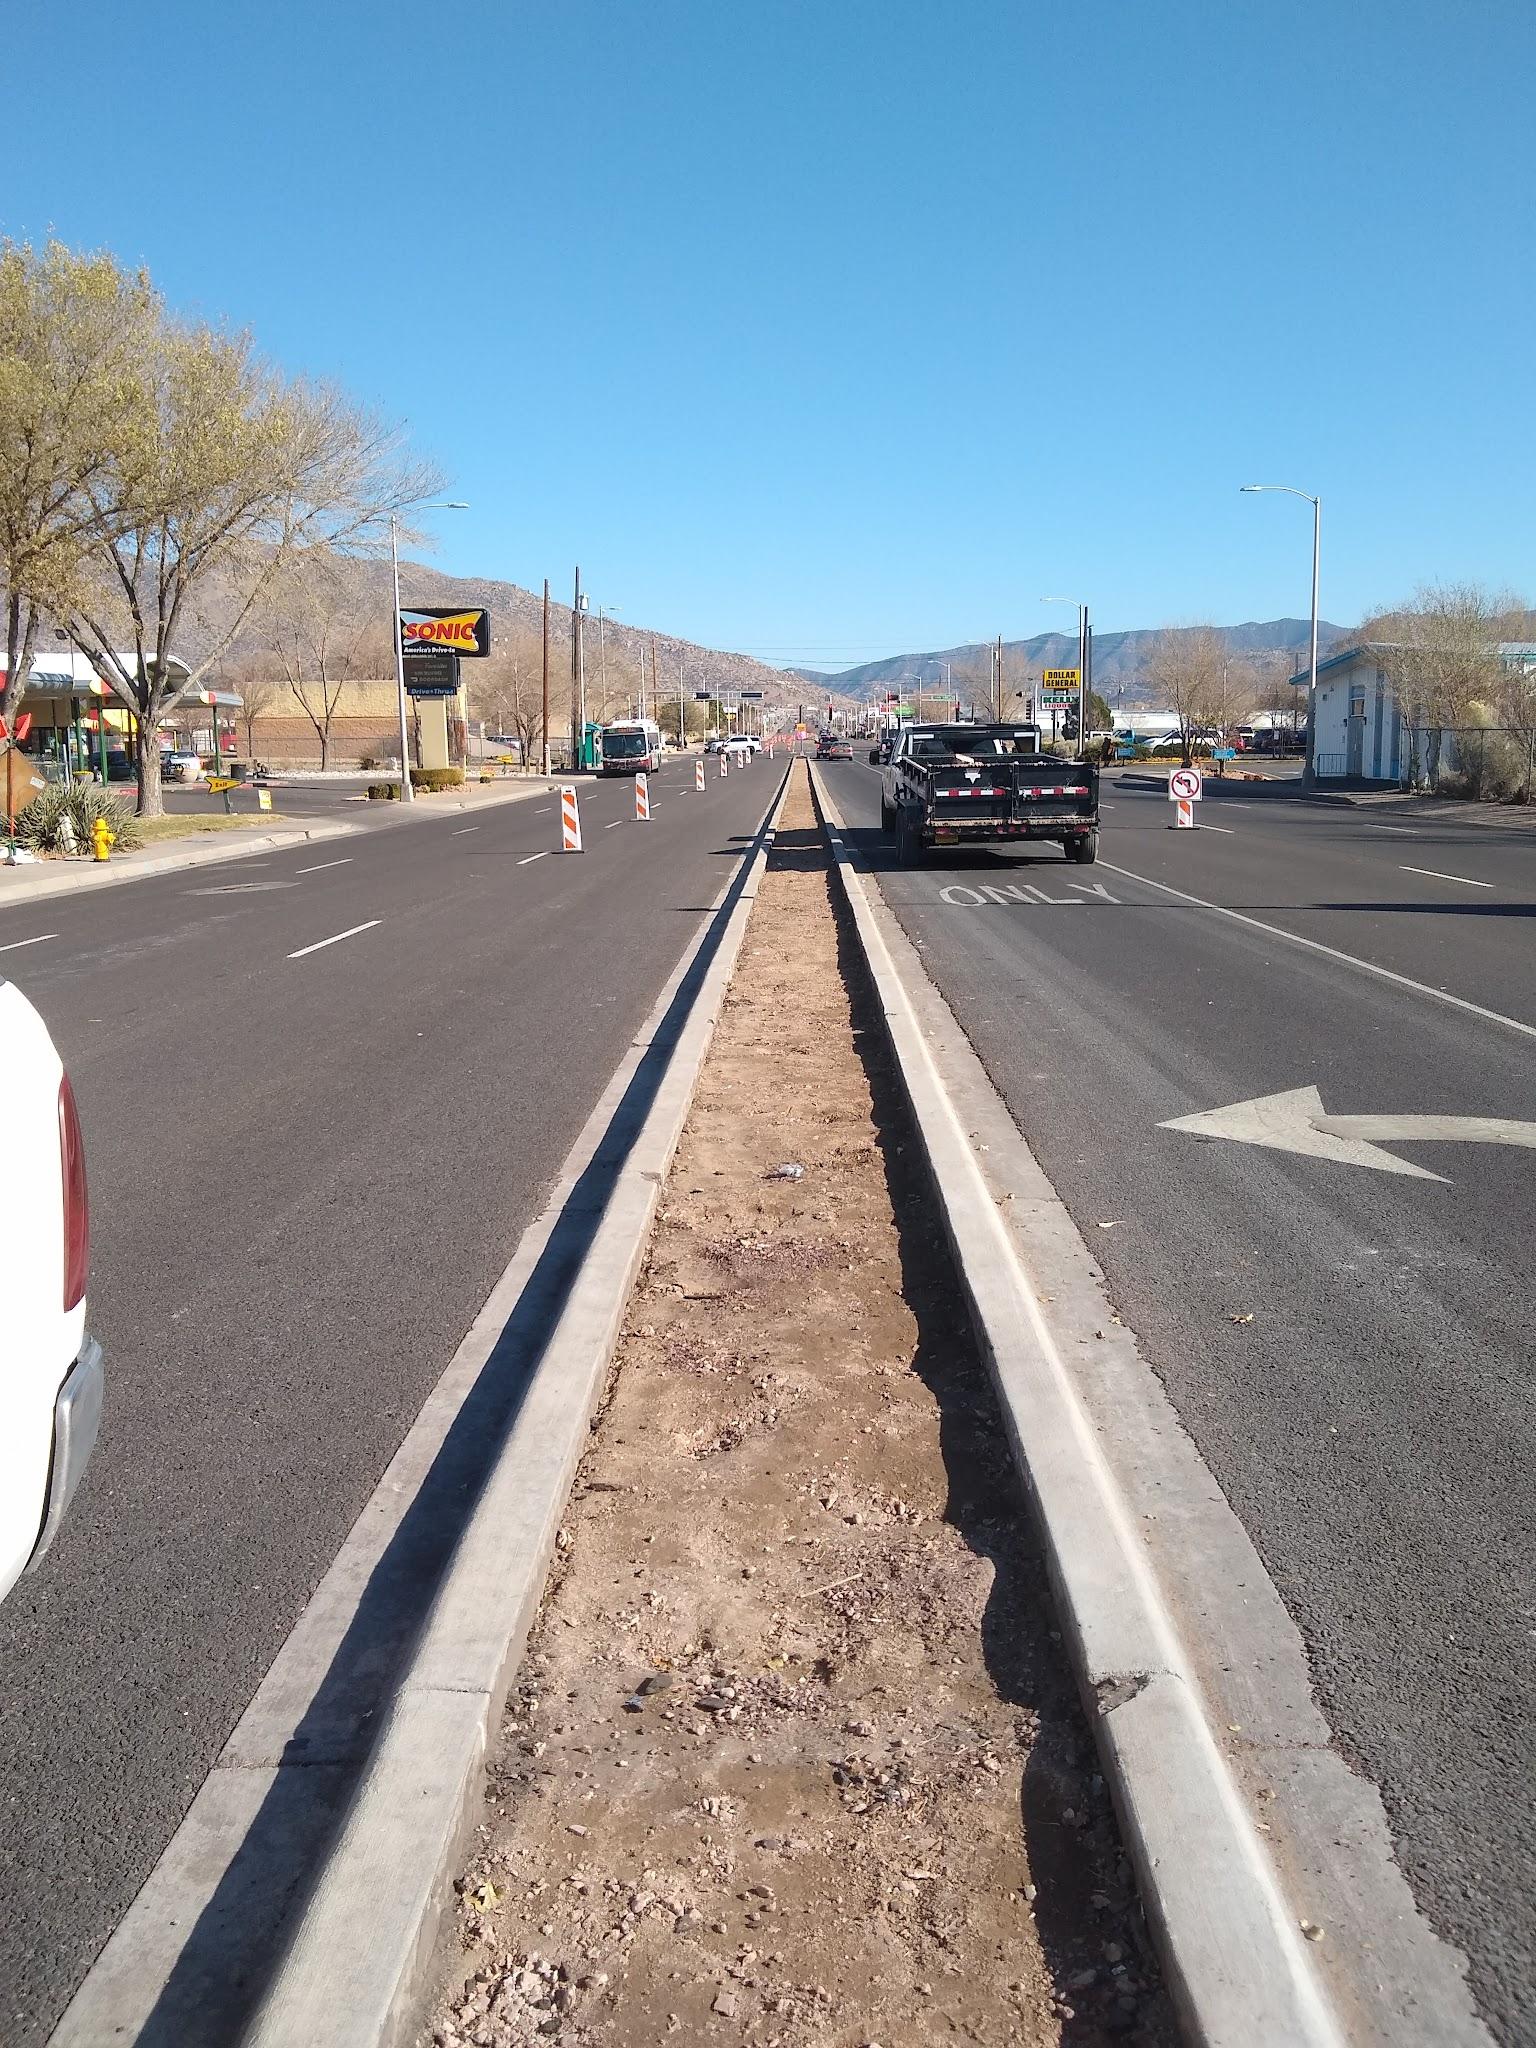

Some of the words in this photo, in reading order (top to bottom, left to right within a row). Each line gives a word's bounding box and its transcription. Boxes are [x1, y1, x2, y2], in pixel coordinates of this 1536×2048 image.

[403, 622, 475, 640] SONIC
[1048, 671, 1076, 679] DOLLAR
[1045, 679, 1079, 687] GENERAL
[939, 883, 1122, 907] ONLY
